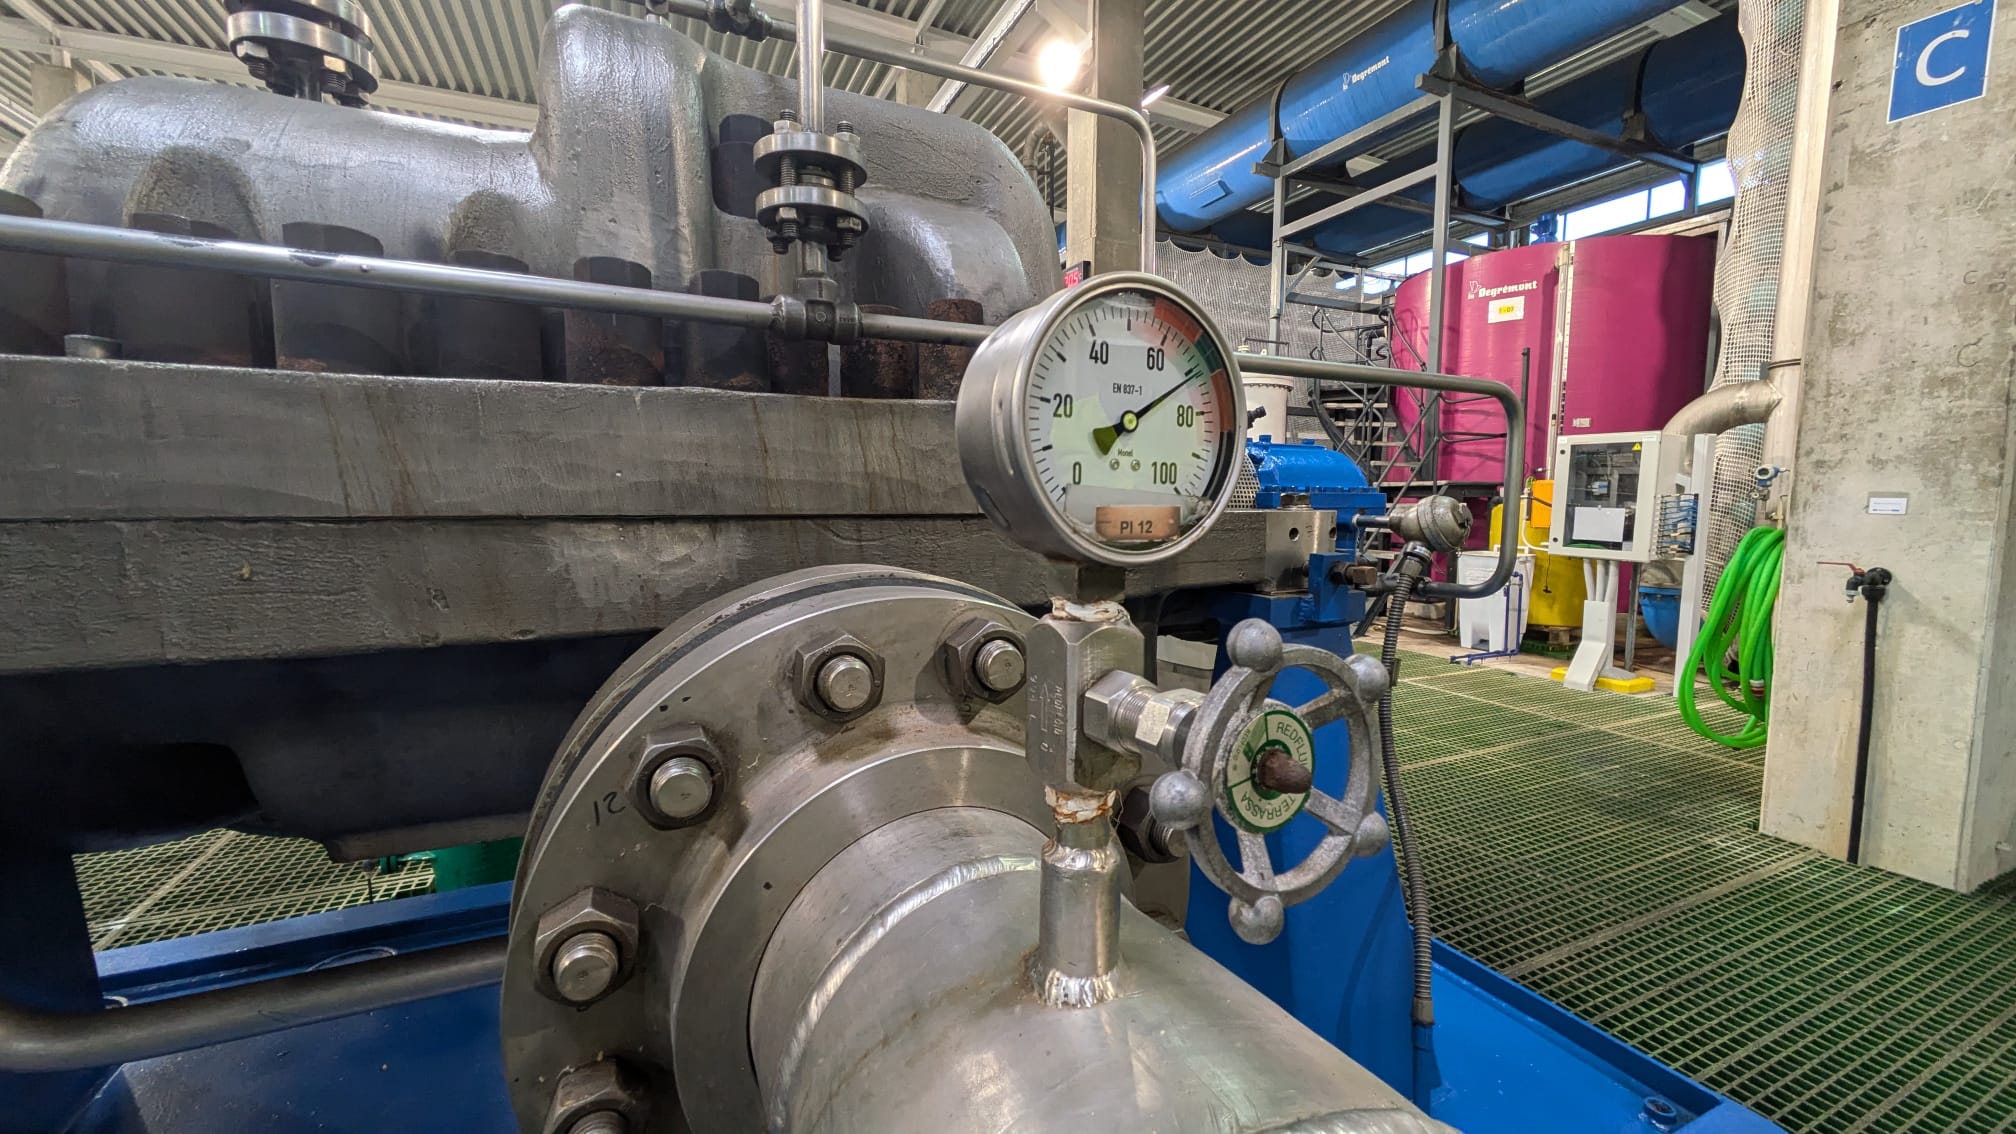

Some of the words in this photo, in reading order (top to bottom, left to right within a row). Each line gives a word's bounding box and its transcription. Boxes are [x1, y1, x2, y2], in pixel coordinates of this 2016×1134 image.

[1915, 29, 1970, 87] C
[1089, 340, 1109, 365] 40
[1146, 347, 1165, 371] 60
[1112, 382, 1122, 394] EN
[1123, 384, 1143, 396] 837-1
[1053, 393, 1073, 418] 20
[1176, 405, 1194, 428] 80
[1072, 461, 1082, 485] 0
[1151, 461, 1177, 485] 100
[1120, 520, 1133, 535] PI
[1137, 520, 1153, 534] 12
[1276, 721, 1308, 766] REDFLUI
[593, 791, 627, 827] 12
[1241, 792, 1296, 820] TERRASSA
